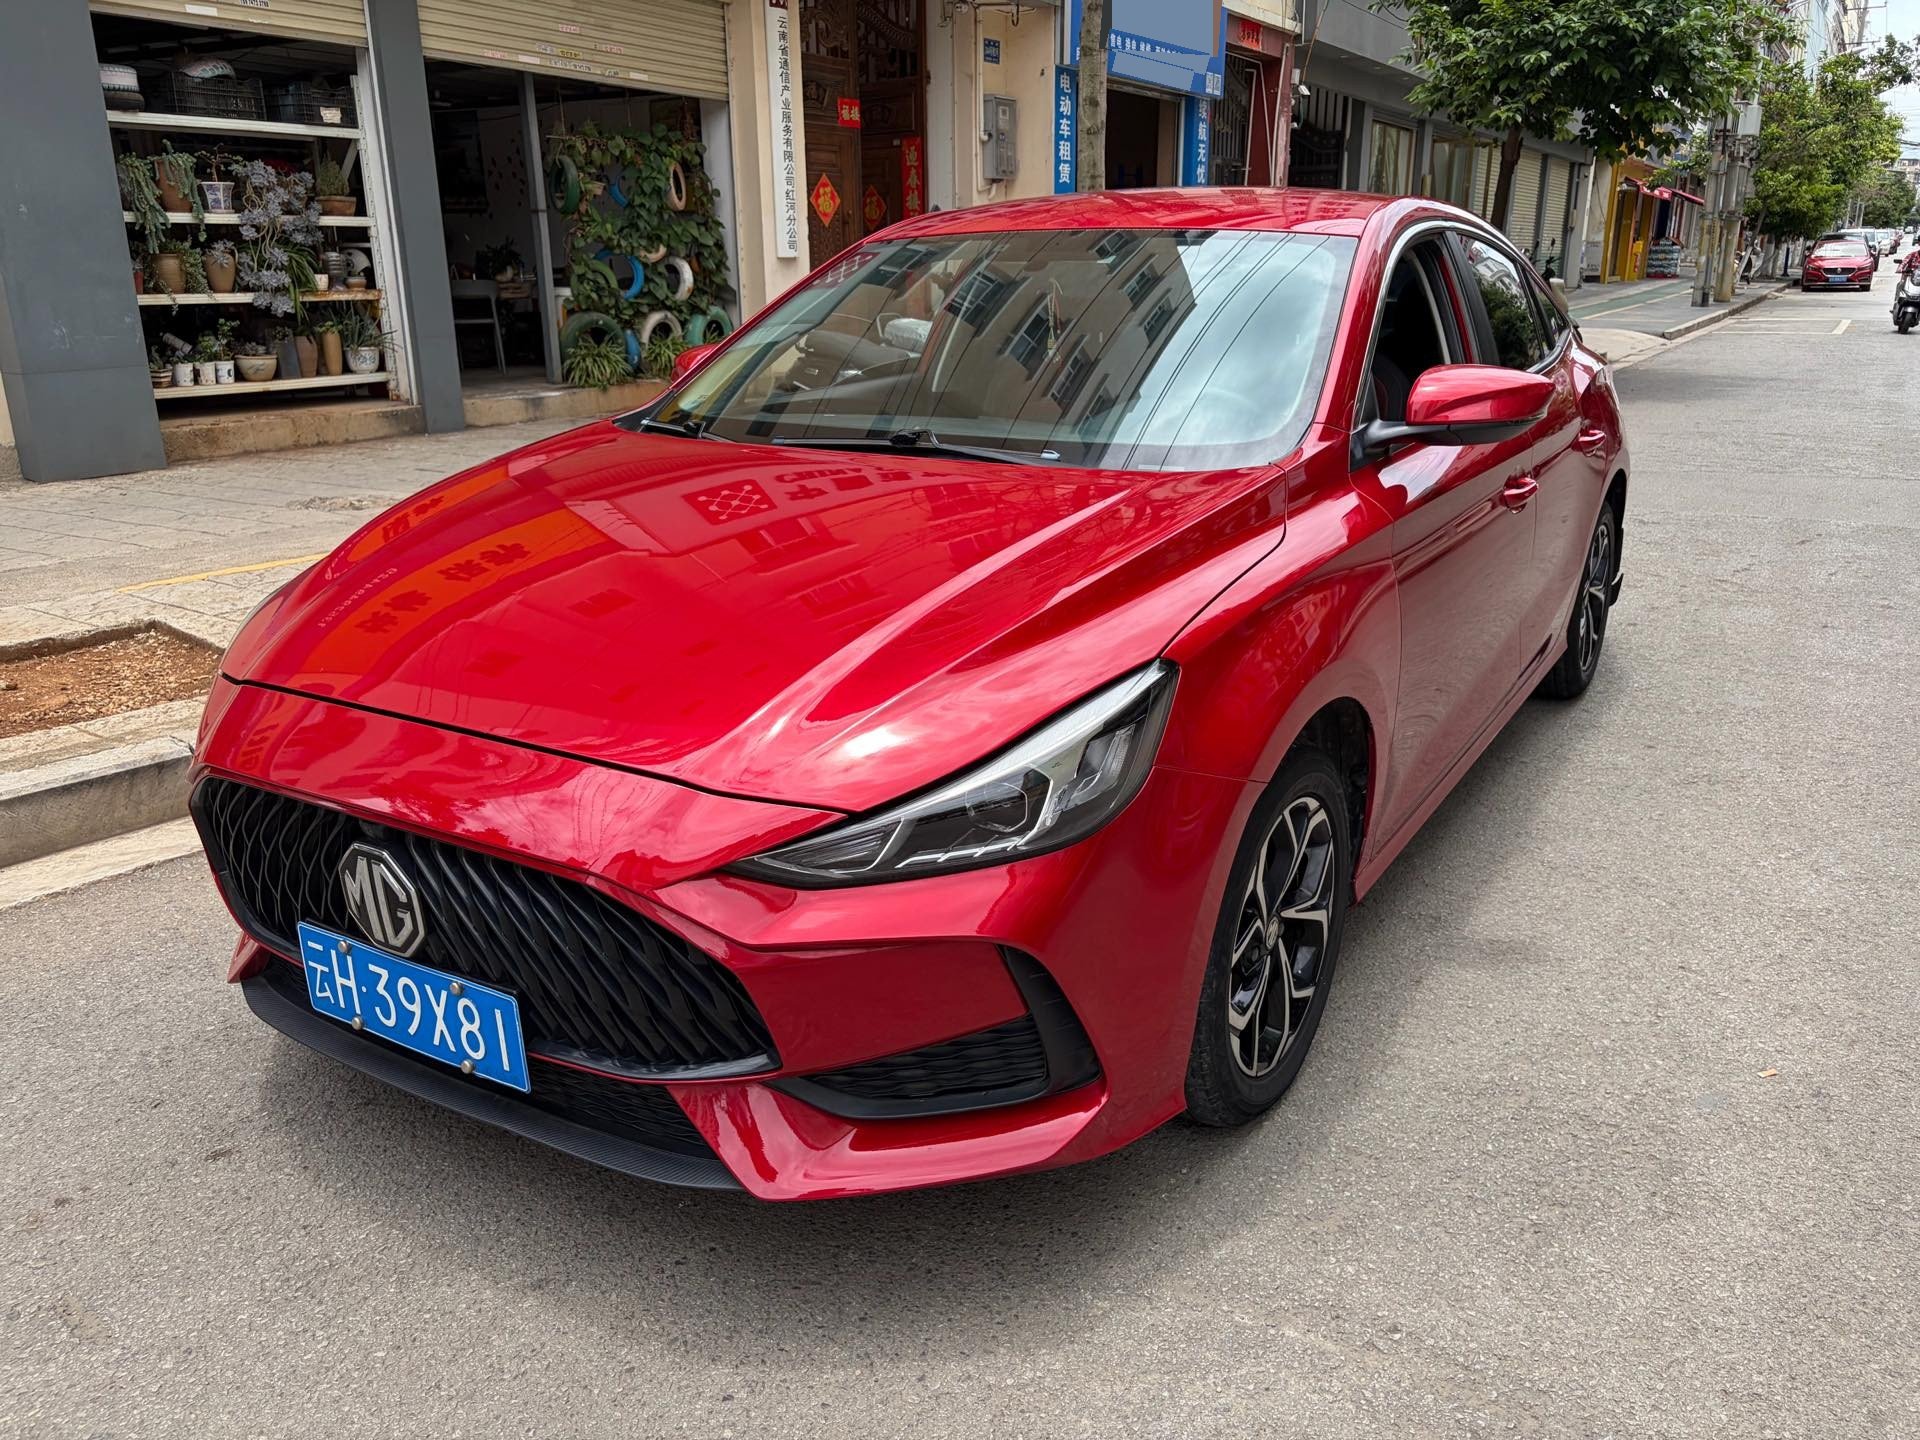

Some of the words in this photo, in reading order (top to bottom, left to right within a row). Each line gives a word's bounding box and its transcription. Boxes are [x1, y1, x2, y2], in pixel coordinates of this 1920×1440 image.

[776, 15, 799, 253] 云南省通信产业服务有限公司红河分公司
[1058, 72, 1072, 184] 电动车租赁
[1196, 100, 1208, 185] 续航无忧
[344, 855, 414, 948] MG
